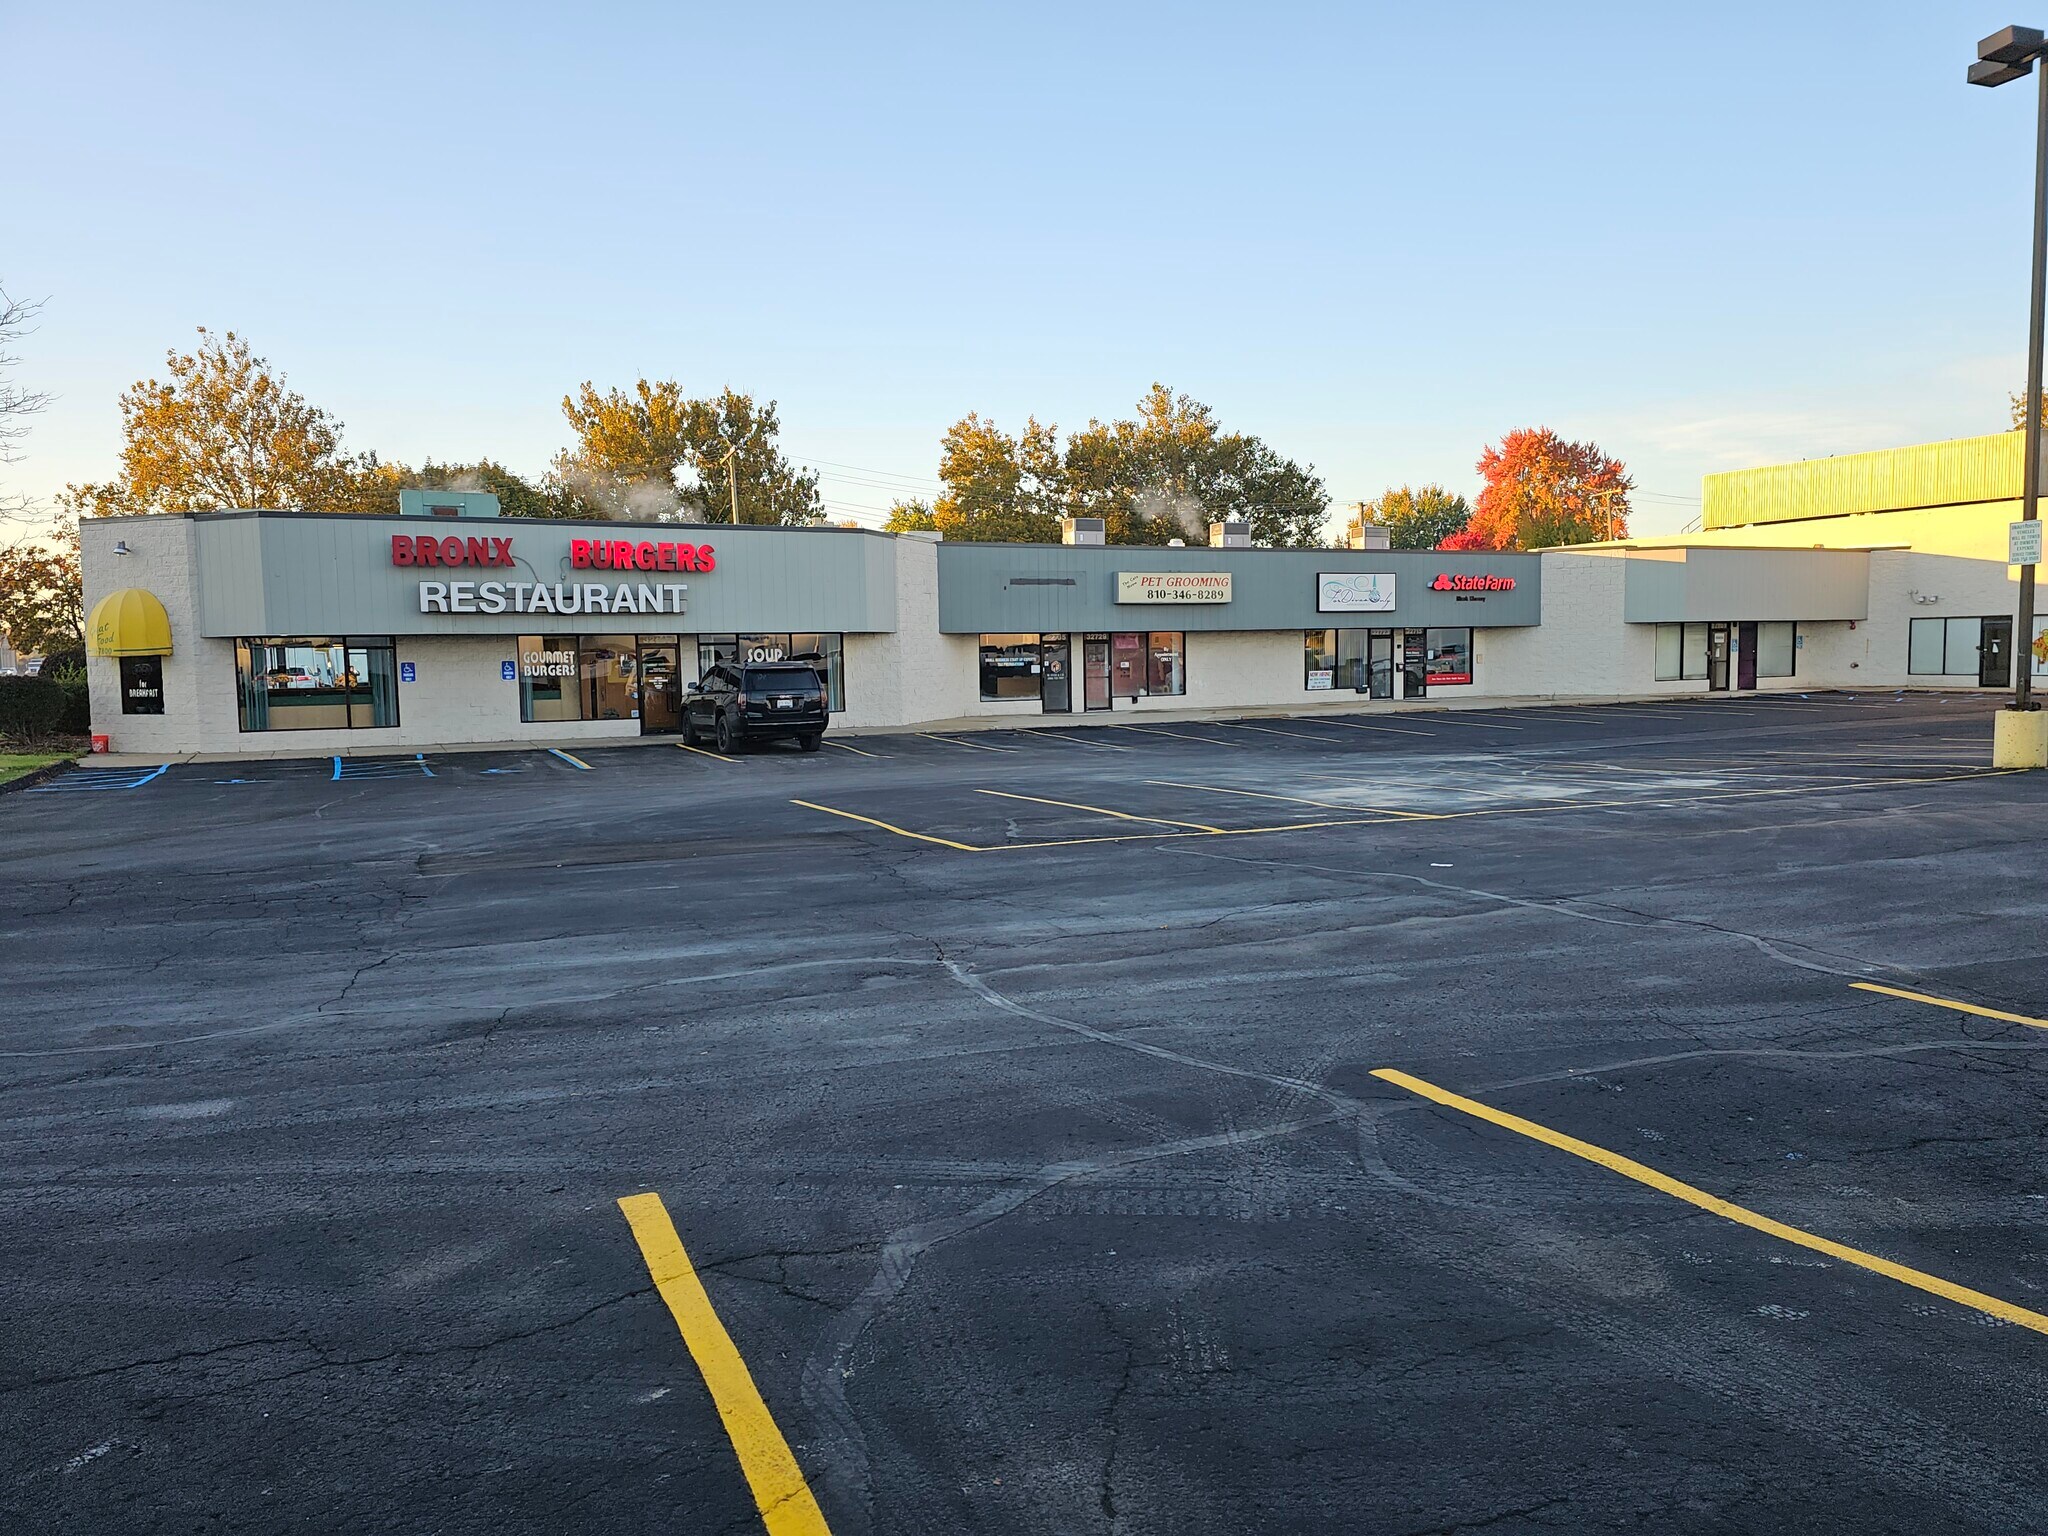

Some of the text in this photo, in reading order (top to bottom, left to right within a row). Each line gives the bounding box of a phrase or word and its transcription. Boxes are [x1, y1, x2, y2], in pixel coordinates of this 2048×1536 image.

[391, 535, 516, 568] BRONX
[570, 538, 716, 573] BURGERS
[1140, 576, 1230, 587] PET GROOMING
[419, 581, 688, 614] RESTAURANT
[1147, 589, 1224, 600] 810-346-8289
[97, 632, 115, 644] Food
[523, 651, 575, 664] GOURMET
[747, 648, 783, 663] SOUP
[524, 664, 575, 676] BURGERS
[129, 689, 158, 697] BREAKFAST
